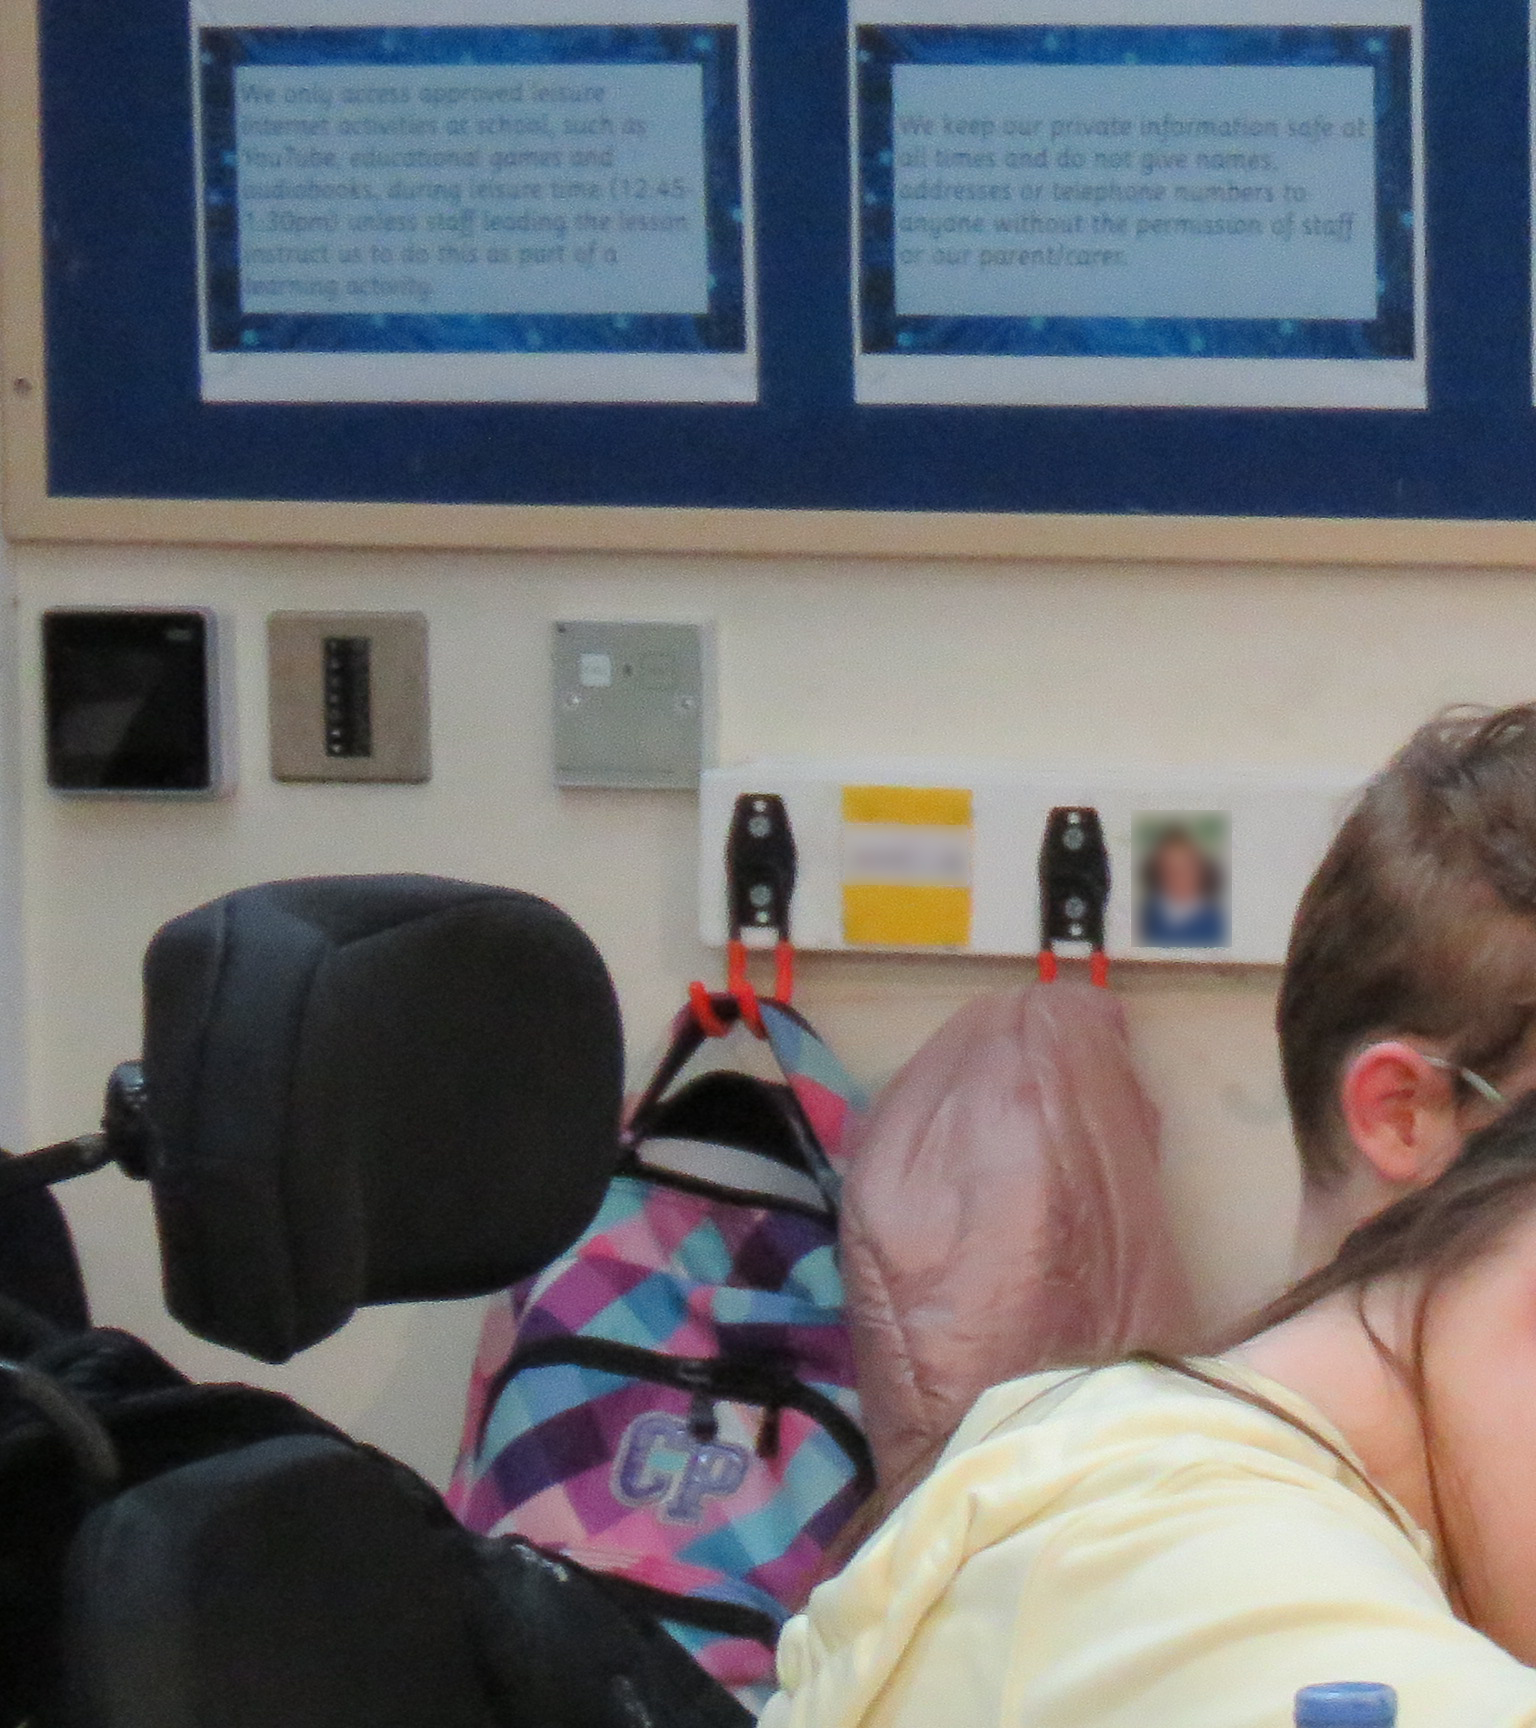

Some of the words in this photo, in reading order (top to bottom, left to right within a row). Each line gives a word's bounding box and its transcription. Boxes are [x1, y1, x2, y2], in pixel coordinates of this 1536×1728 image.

[242, 86, 275, 103] We
[283, 86, 332, 109] only
[418, 86, 523, 108] approved
[336, 117, 437, 135] activities
[445, 120, 467, 135] at
[477, 116, 554, 138] school,
[563, 117, 614, 135] such
[621, 120, 646, 135] as
[901, 119, 932, 137] We
[943, 119, 995, 142] keep
[1004, 122, 1042, 137] our
[1050, 120, 1131, 144] private
[1140, 117, 1279, 142] information
[1287, 118, 1333, 144] safe
[1342, 120, 1366, 138] at
[349, 148, 479, 168] educational
[488, 151, 561, 174] games
[570, 148, 613, 168] and
[901, 152, 927, 169] all
[935, 152, 996, 169] times
[1004, 151, 1047, 169] and
[1057, 151, 1085, 169] do
[1095, 154, 1131, 169] not
[1141, 153, 1187, 175] give
[387, 182, 461, 205] during
[550, 181, 600, 199] time
[901, 183, 1011, 201] addresses
[1020, 186, 1043, 201] or
[1053, 183, 1165, 206] telephone
[1175, 184, 1275, 202] numbers
[1284, 185, 1307, 202] to
[348, 213, 417, 232] unless
[426, 208, 475, 238] staff
[482, 212, 566, 238] leading
[575, 212, 610, 232] the
[619, 212, 687, 232] lesson
[901, 218, 984, 239] anyone
[993, 216, 1083, 233] without
[1092, 216, 1128, 233] the
[1136, 218, 1262, 239] permission
[1271, 214, 1295, 242] of
[1303, 213, 1354, 241] staff
[339, 248, 361, 264] us
[370, 246, 392, 264] to
[402, 245, 430, 264] do
[438, 245, 477, 264] this
[486, 248, 510, 264] as
[518, 246, 565, 269] part
[574, 241, 596, 270] of
[604, 248, 617, 264] a
[901, 249, 922, 265] or
[932, 249, 970, 265] our
